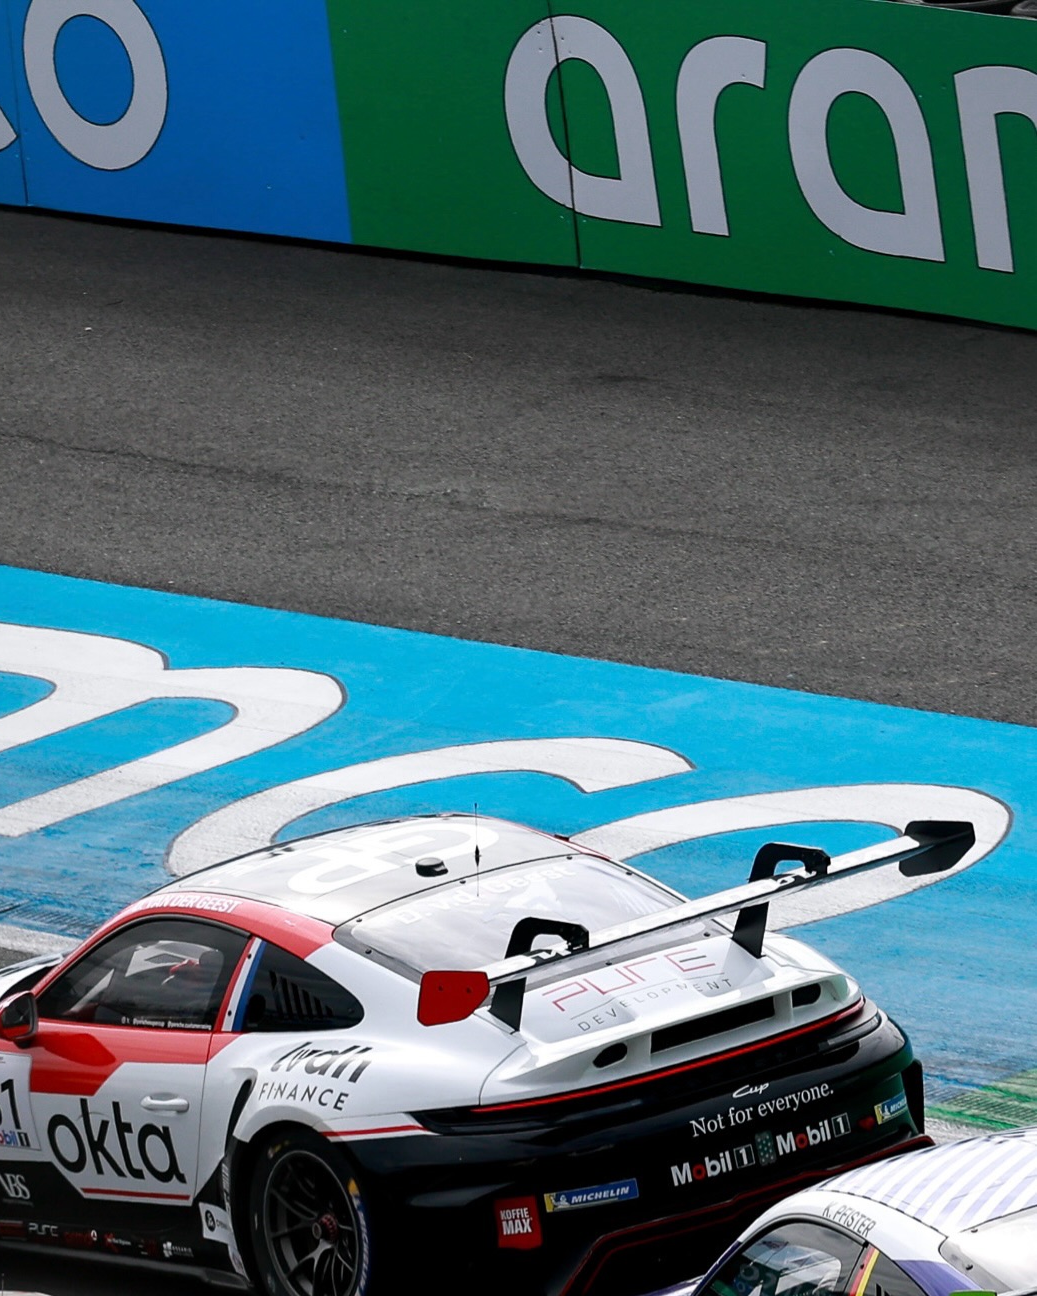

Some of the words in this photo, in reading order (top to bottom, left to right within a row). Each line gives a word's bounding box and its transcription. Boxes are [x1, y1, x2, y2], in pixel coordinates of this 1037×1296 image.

[169, 895, 197, 909] DER
[195, 896, 243, 914] GEEST
[576, 977, 733, 1032] DEVELOPMENT
[259, 1081, 350, 1111] FINANCE
[731, 1081, 770, 1099] Cup
[689, 1112, 726, 1138] Not
[727, 1105, 754, 1128] for
[757, 1081, 835, 1118] everyone.
[47, 1097, 188, 1185] okta
[775, 1119, 832, 1156] Mobil
[670, 1150, 733, 1187] Mobil
[570, 1185, 630, 1204] MICHELIN
[500, 1207, 529, 1220] KOFFIE
[502, 1217, 532, 1236] MAX
[832, 1204, 877, 1238] PFISTER
